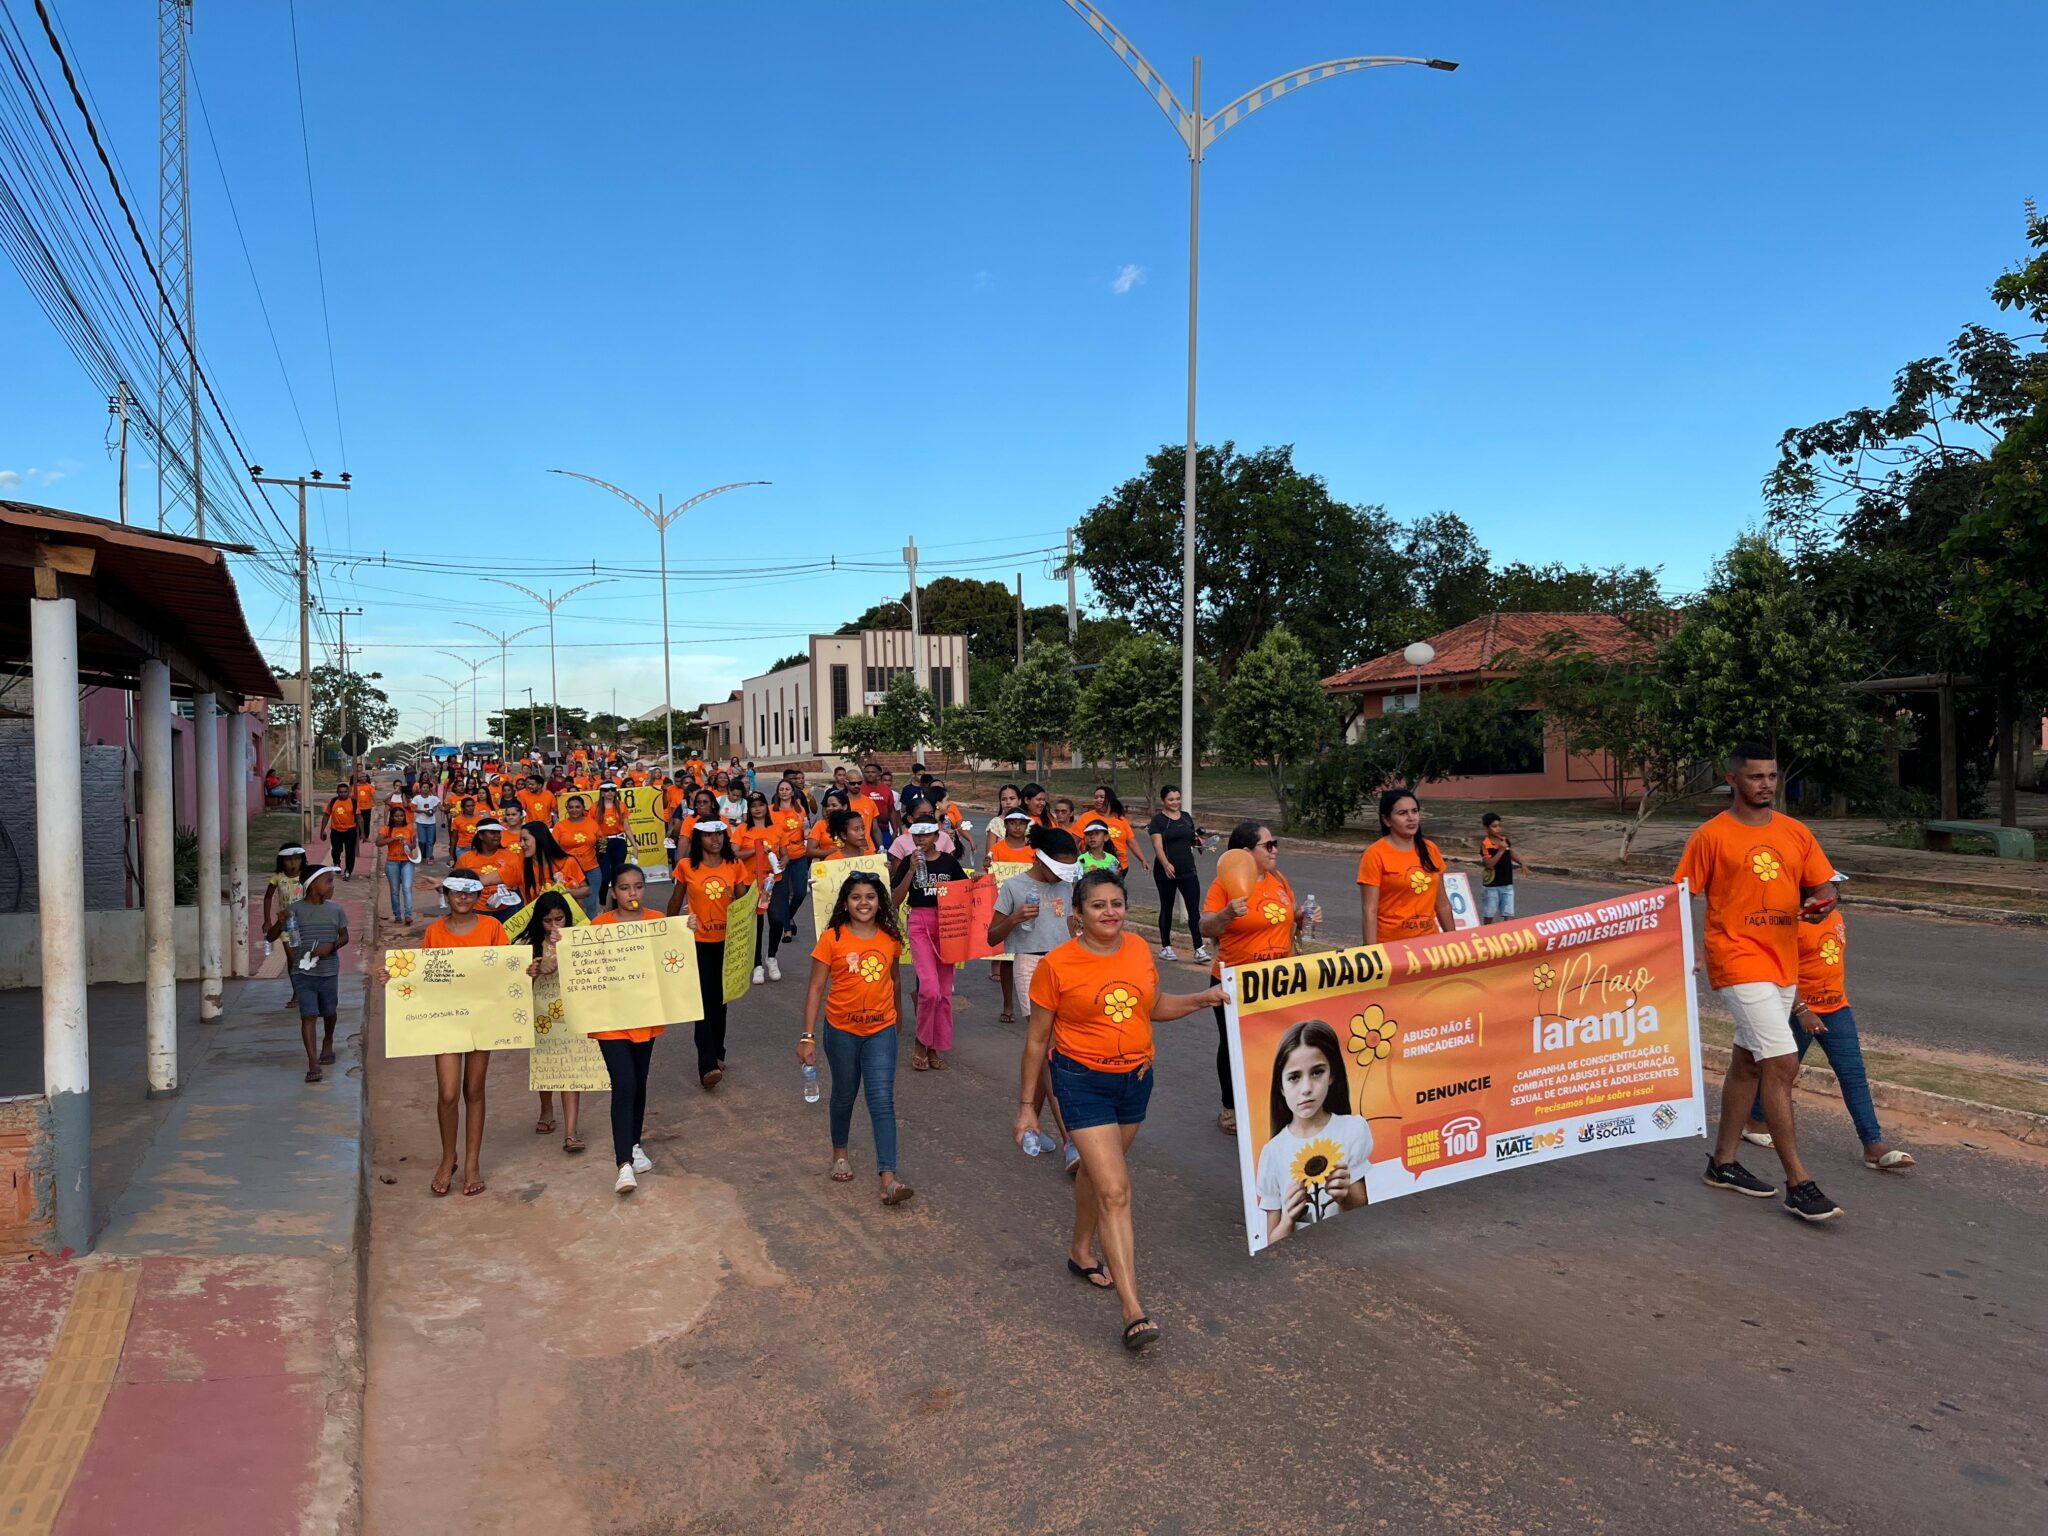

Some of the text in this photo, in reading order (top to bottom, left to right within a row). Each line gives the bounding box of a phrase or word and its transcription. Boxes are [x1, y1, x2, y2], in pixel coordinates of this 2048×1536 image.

[1535, 895, 1665, 936] CONTRA CRIANÇAS
[1744, 915, 1792, 927] FAÇA BONITO
[572, 920, 668, 945] FAÇA BONITO
[1545, 914, 1659, 951] E ADOLESCENTES
[571, 949, 592, 959] ABUSO
[617, 945, 645, 953] SEGREDO
[1242, 928, 1538, 1004] DIGA NÃO! À VIOLÊNCIA
[569, 978, 591, 986] TODA
[1556, 952, 1655, 1016] Maio
[1403, 1017, 1472, 1044] ABUSO NÃO É
[1533, 999, 1659, 1053] laranja
[1403, 1033, 1475, 1058] BRINCADEIRA!
[1512, 1056, 1675, 1094] COMBATE AO ABUSO E À EXPLORAÇÃO
[1516, 1044, 1670, 1080] CAMPANHA DE CONSCIENTIZAÇÃO E
[1416, 1076, 1491, 1104] DENUNCIE
[1510, 1068, 1680, 1107] SEXUAL DE CRIANÇAS E ADOLESCENTES
[1534, 1085, 1655, 1116] Precisamos falar sobre isso!
[1595, 1117, 1635, 1130] ASSISTÊNCIA
[1596, 1127, 1636, 1140] SOCIAL
[1407, 1129, 1439, 1148] DISQUE
[1407, 1142, 1440, 1158] DIREITOS
[1444, 1130, 1478, 1157] 100
